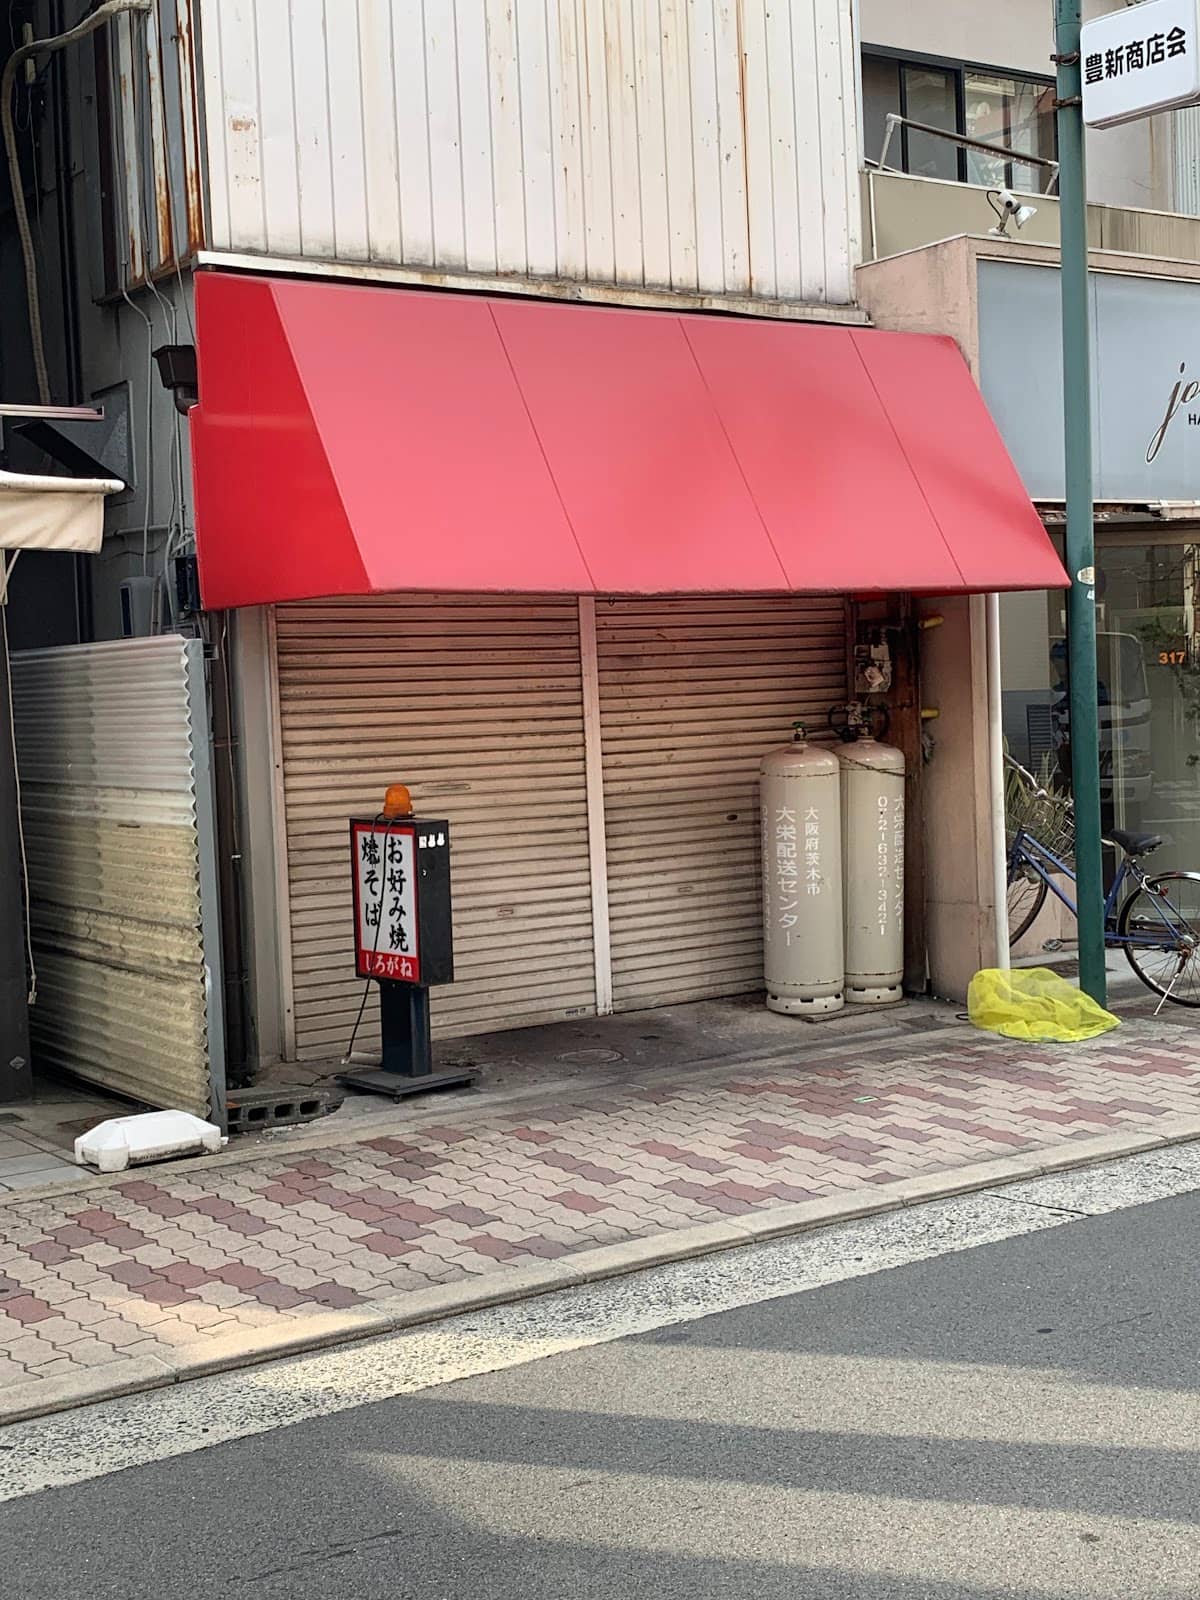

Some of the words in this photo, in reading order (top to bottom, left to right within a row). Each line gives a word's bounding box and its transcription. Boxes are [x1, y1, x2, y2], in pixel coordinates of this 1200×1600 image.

[1085, 26, 1186, 85] 豊新商店会
[1159, 652, 1185, 664] 317
[361, 836, 380, 926] 焼そば
[387, 836, 409, 953] お好み焼
[775, 806, 798, 947] 大栄配送センター
[804, 806, 821, 897] 大阪府茨木市
[364, 952, 413, 978] しろがね
